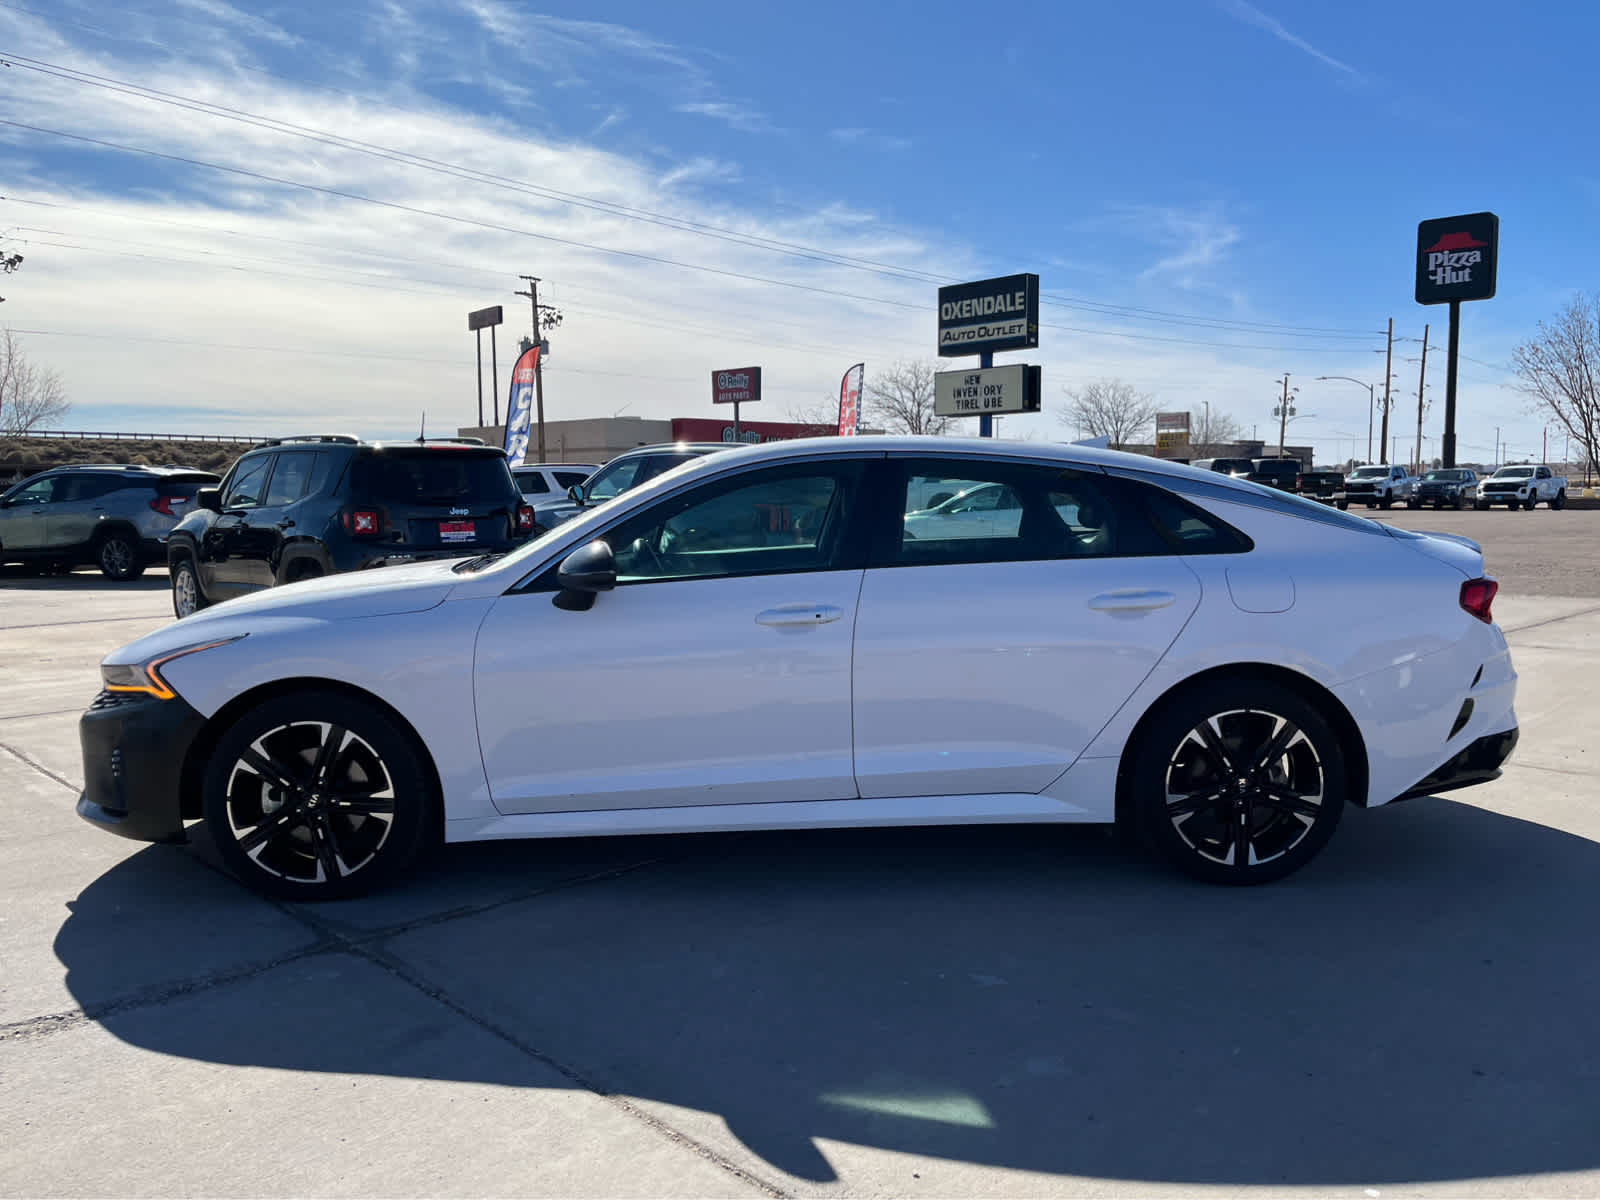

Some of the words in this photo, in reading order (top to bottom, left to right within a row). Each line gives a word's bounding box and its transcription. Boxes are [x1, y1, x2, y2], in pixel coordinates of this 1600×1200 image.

[1428, 250, 1481, 271] Pizza
[1428, 266, 1472, 285] Hut
[941, 291, 1025, 321] OXENDALE
[942, 331, 976, 343] AUTO
[978, 324, 1024, 338] OUTLET
[964, 375, 981, 385] NEW
[450, 506, 469, 515] Jeep
